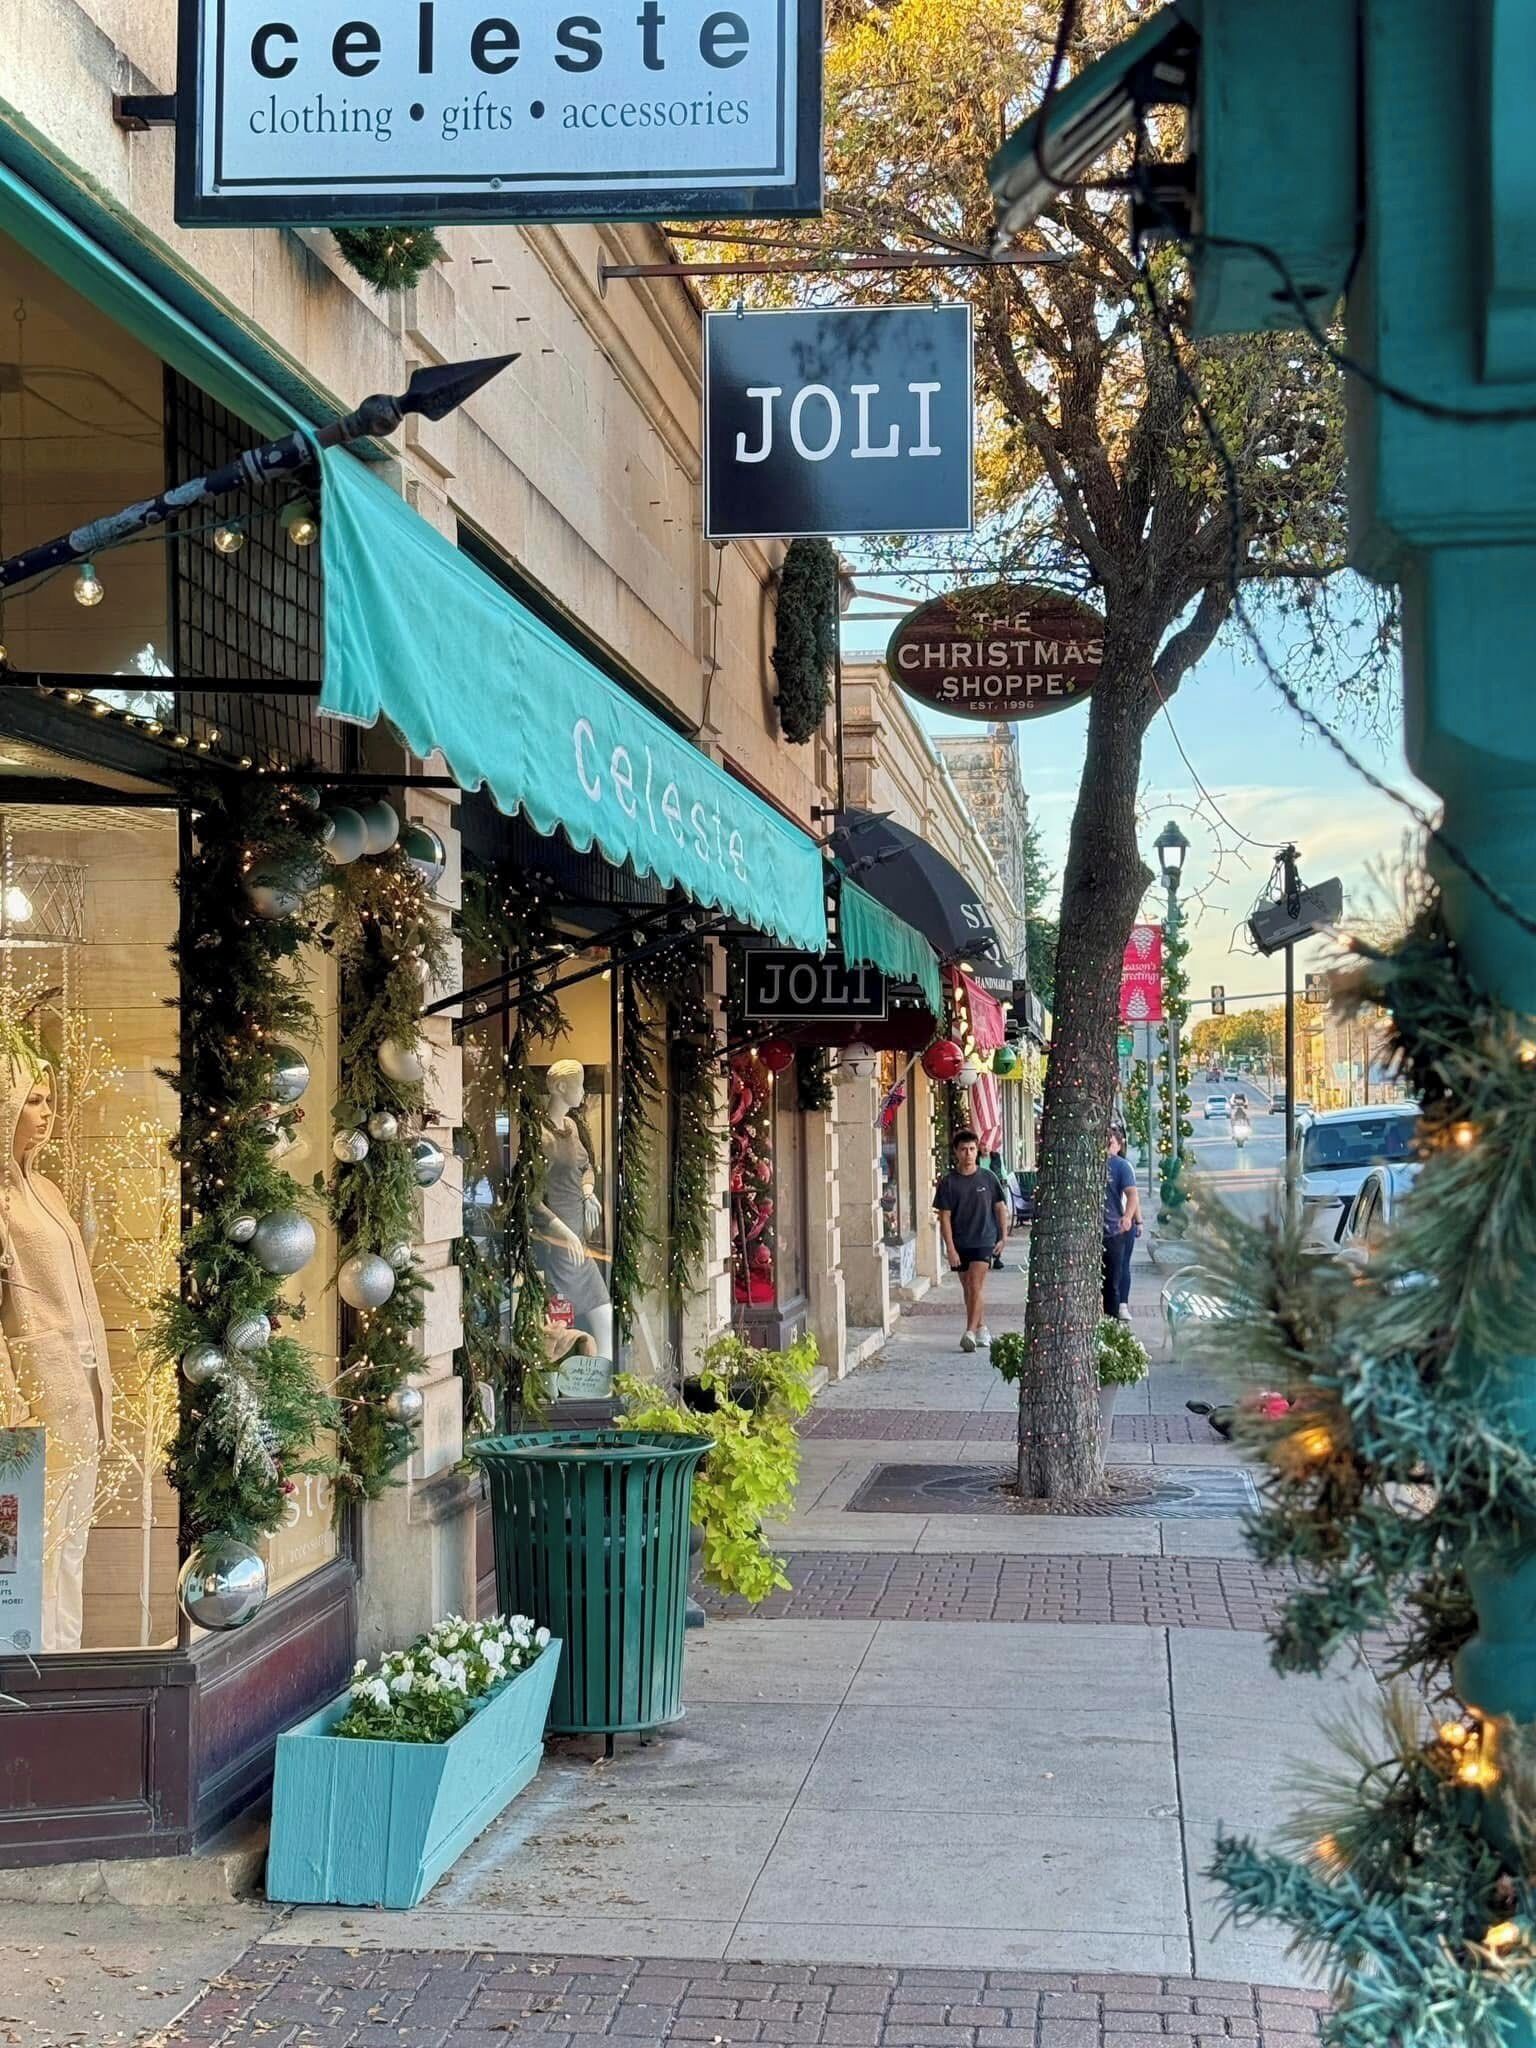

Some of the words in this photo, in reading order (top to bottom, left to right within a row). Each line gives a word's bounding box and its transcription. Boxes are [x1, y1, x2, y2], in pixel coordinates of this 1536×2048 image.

[251, 1, 749, 79] celeste
[249, 93, 393, 142] clothing
[441, 90, 512, 141] gifts
[562, 90, 749, 129] accessories
[736, 382, 941, 463] JOLI
[898, 638, 1105, 669] CHRISTMAS
[942, 673, 1064, 698] SHOPPE
[969, 701, 999, 711] EST.
[1003, 700, 1034, 710] 1996
[759, 963, 871, 1004] JOLI
